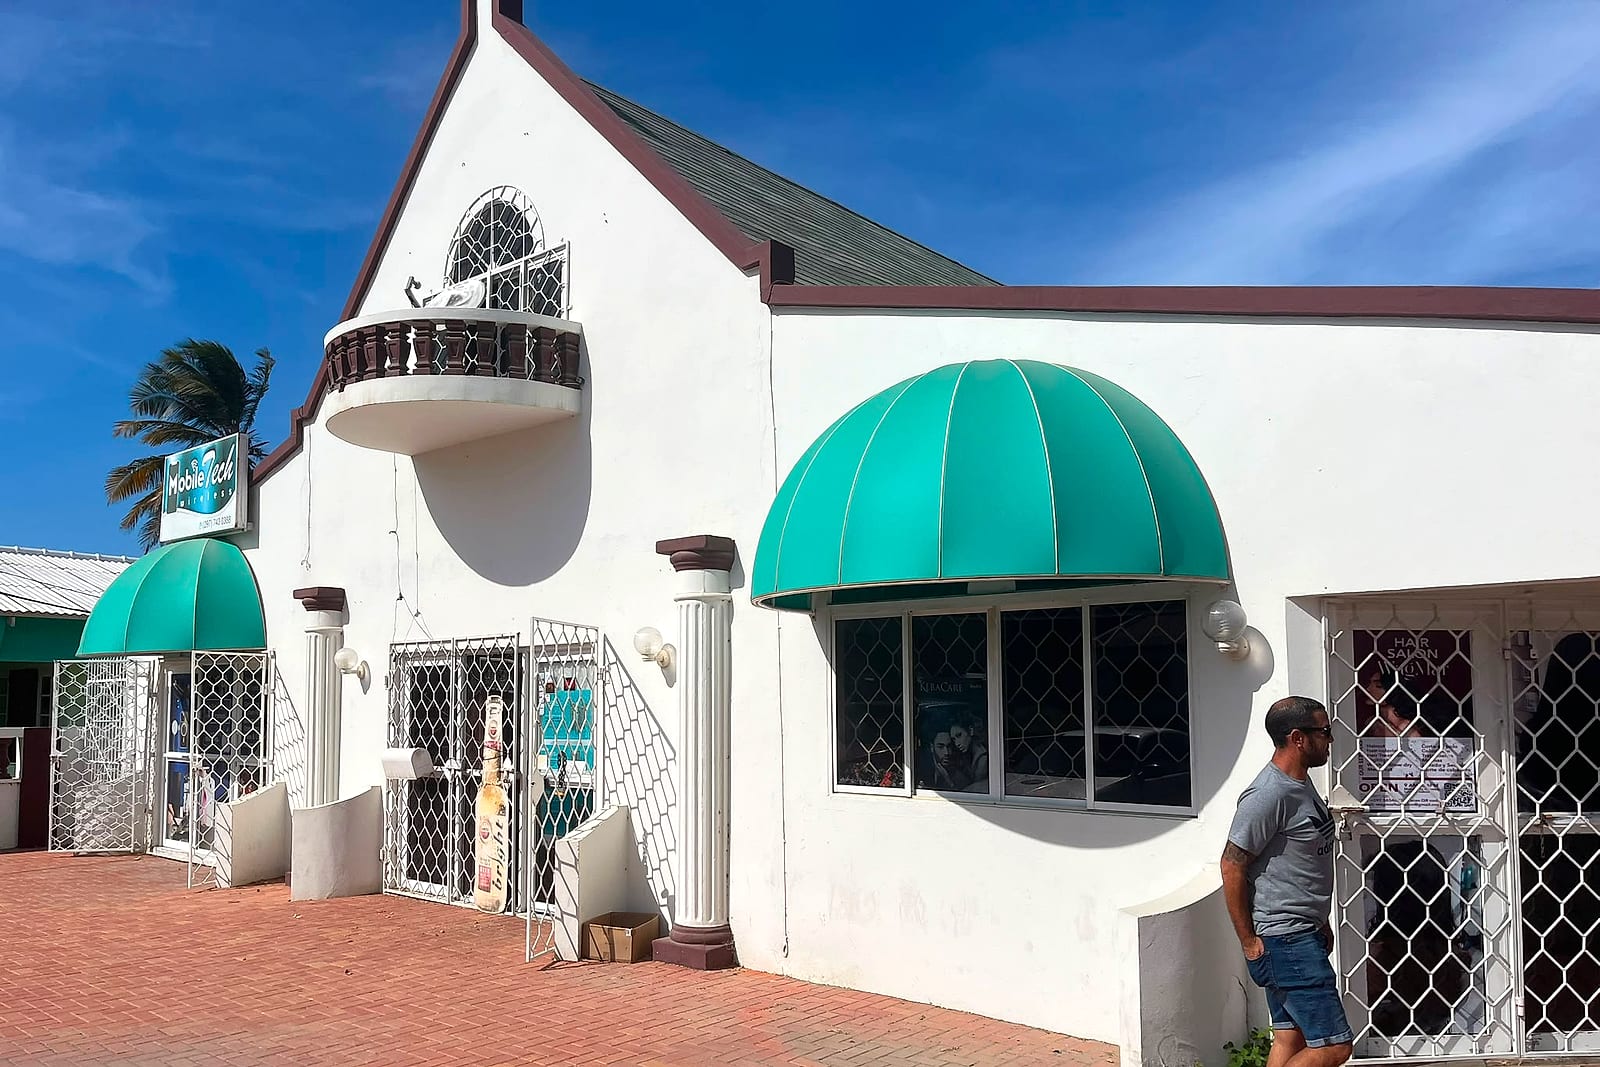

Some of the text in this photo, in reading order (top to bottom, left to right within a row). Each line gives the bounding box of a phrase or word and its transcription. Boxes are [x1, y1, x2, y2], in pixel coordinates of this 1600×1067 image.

[168, 444, 235, 496] Mobile Tech
[1394, 637, 1430, 648] HAR
[1387, 648, 1438, 659] SALON
